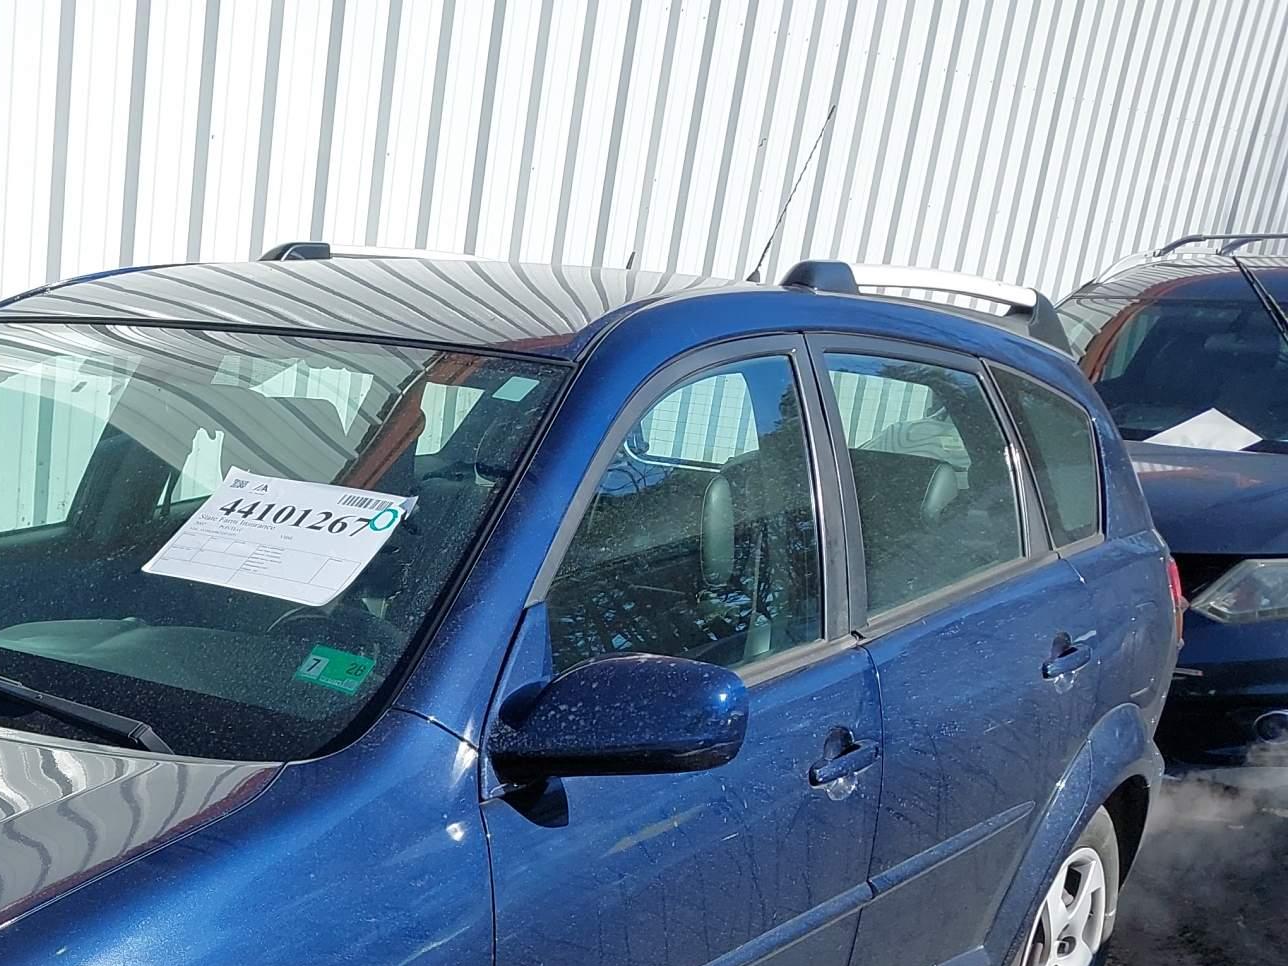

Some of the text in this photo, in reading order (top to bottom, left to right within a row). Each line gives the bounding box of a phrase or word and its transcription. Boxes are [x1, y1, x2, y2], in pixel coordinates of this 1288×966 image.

[219, 498, 372, 537] 44101267
[219, 516, 239, 526] Farm
[240, 519, 276, 531] Insurance
[307, 657, 321, 672] 7
